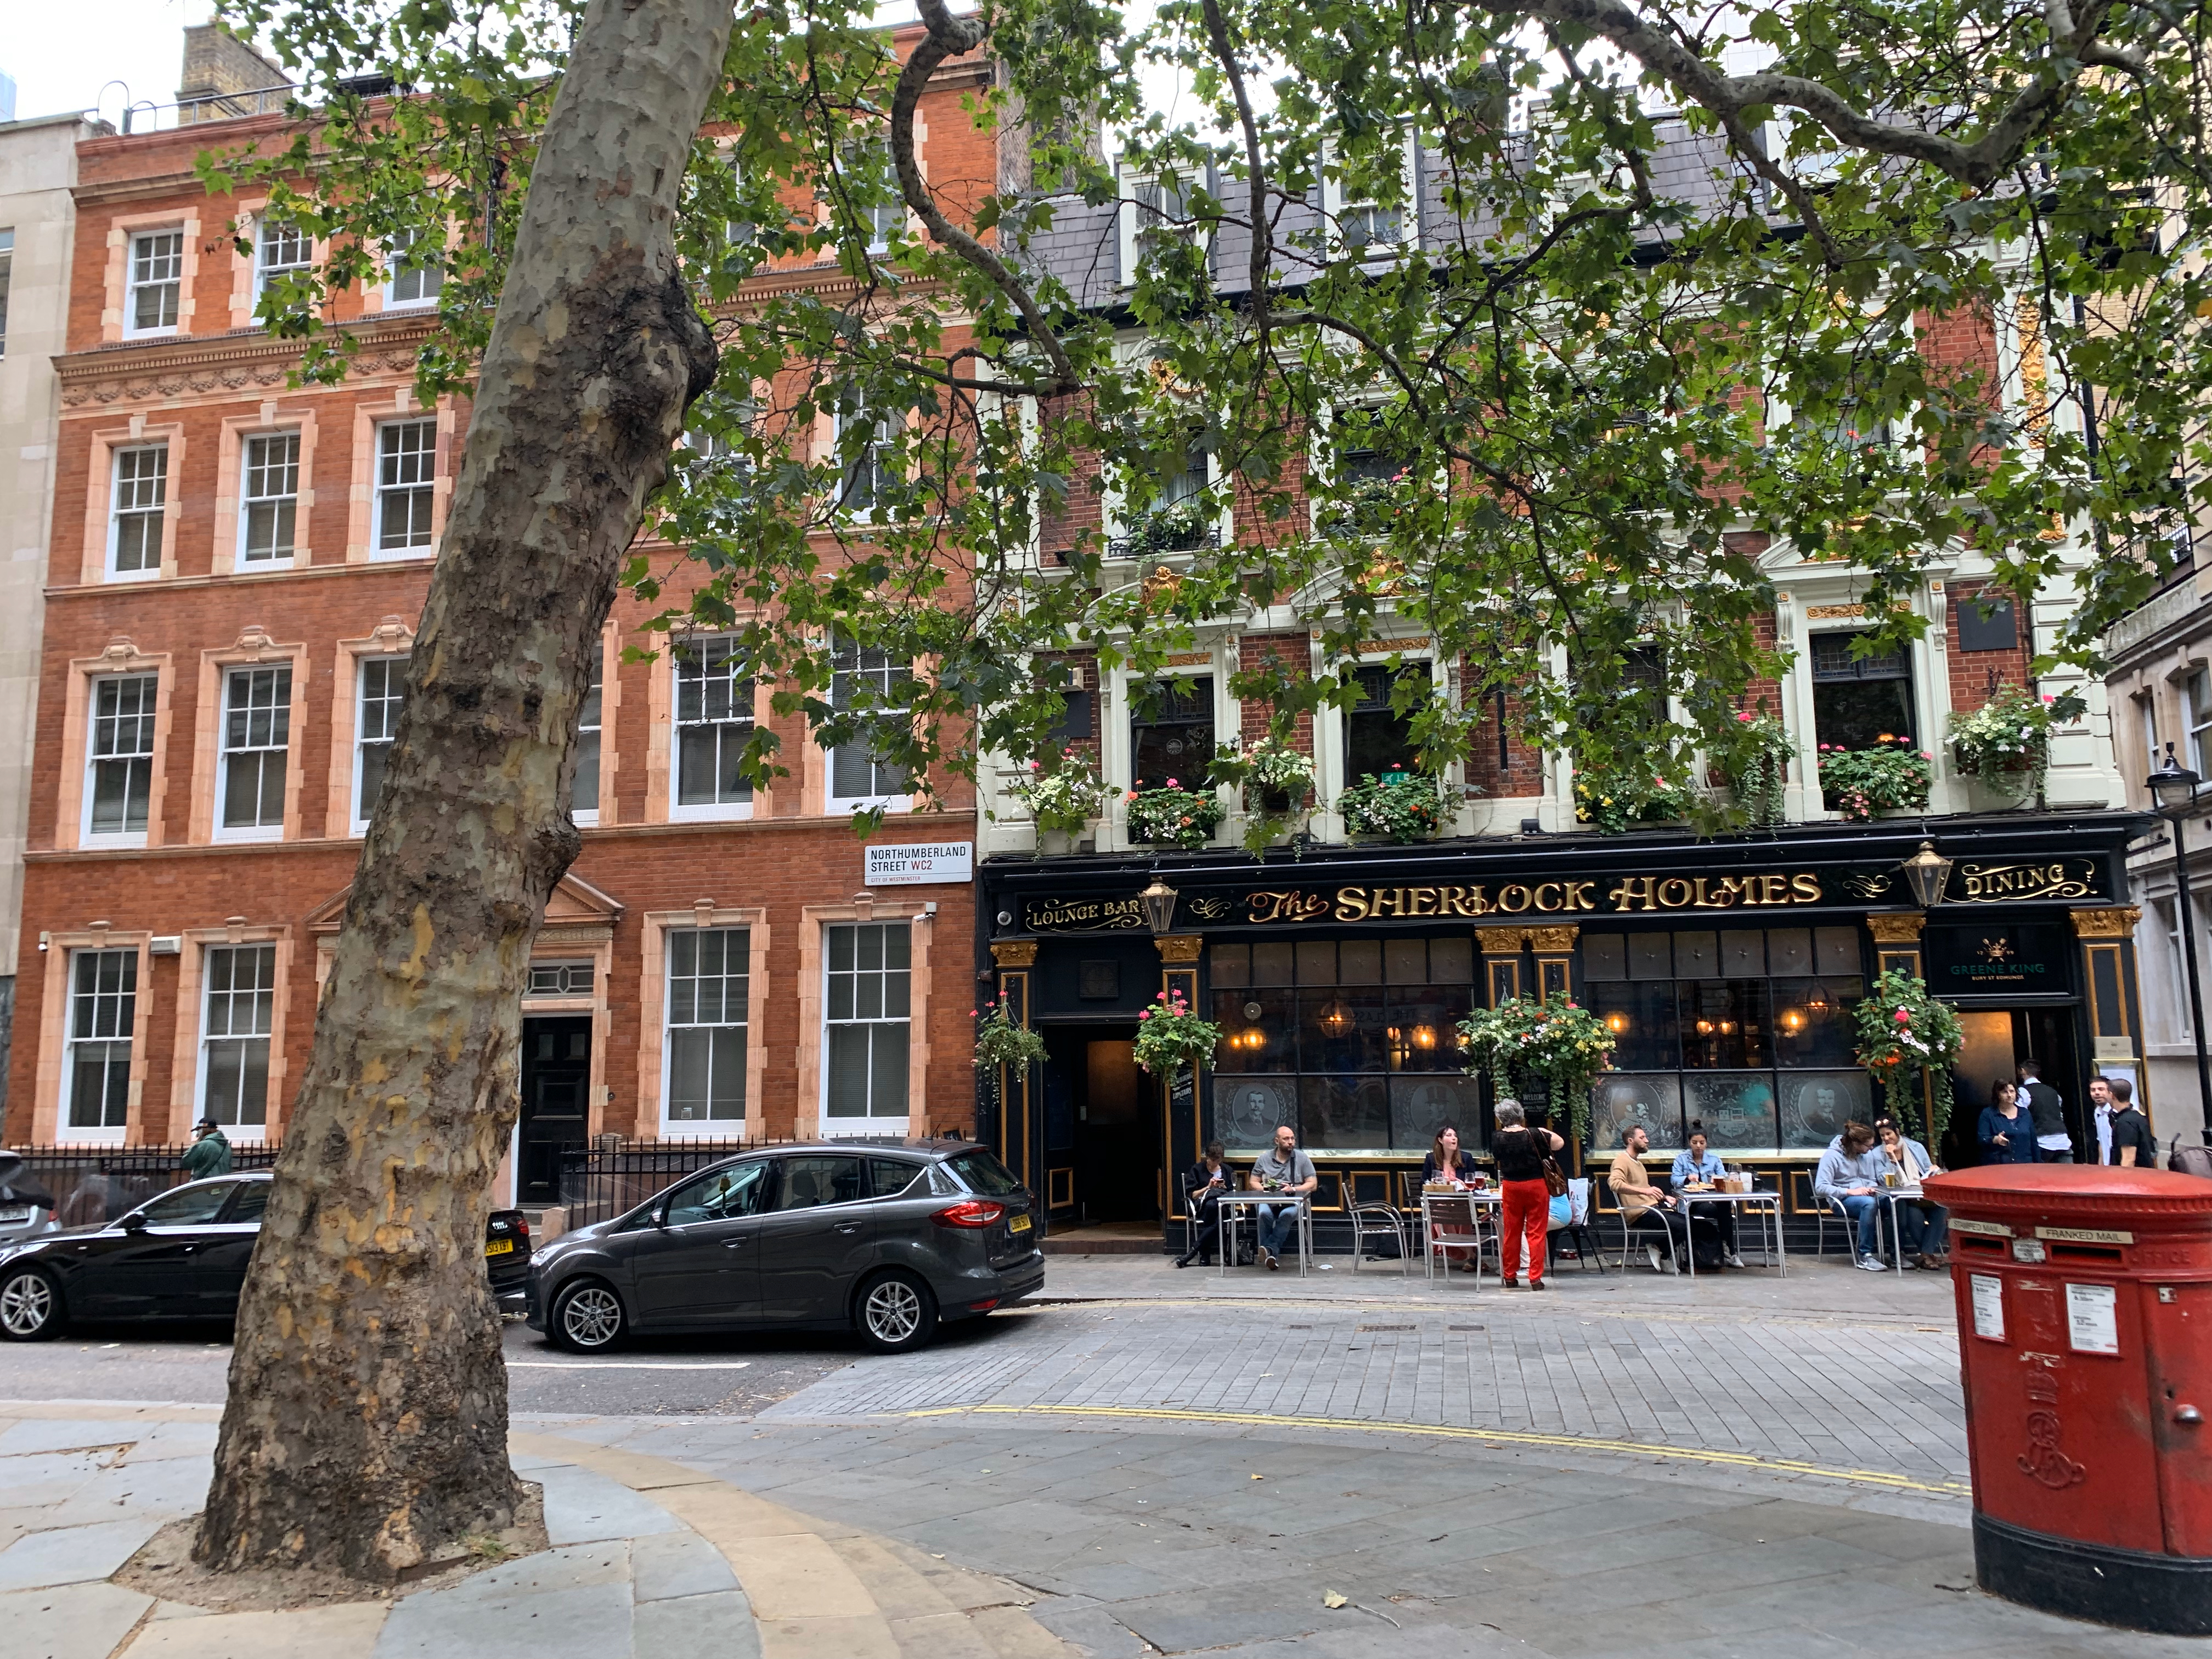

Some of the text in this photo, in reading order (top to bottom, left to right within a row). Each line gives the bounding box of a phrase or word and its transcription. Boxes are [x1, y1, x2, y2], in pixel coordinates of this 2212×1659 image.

[871, 846, 966, 860] NORTHUMBERLAND
[871, 860, 932, 872] STREET WC2
[1965, 864, 2065, 895] DINING
[1246, 873, 1822, 923] The SHERLOCK HOLMES
[1033, 899, 1139, 926] LOUNGE BAR
[1950, 963, 2045, 975] GREENE KING
[2045, 1229, 2122, 1242] FRANKED MAIL
